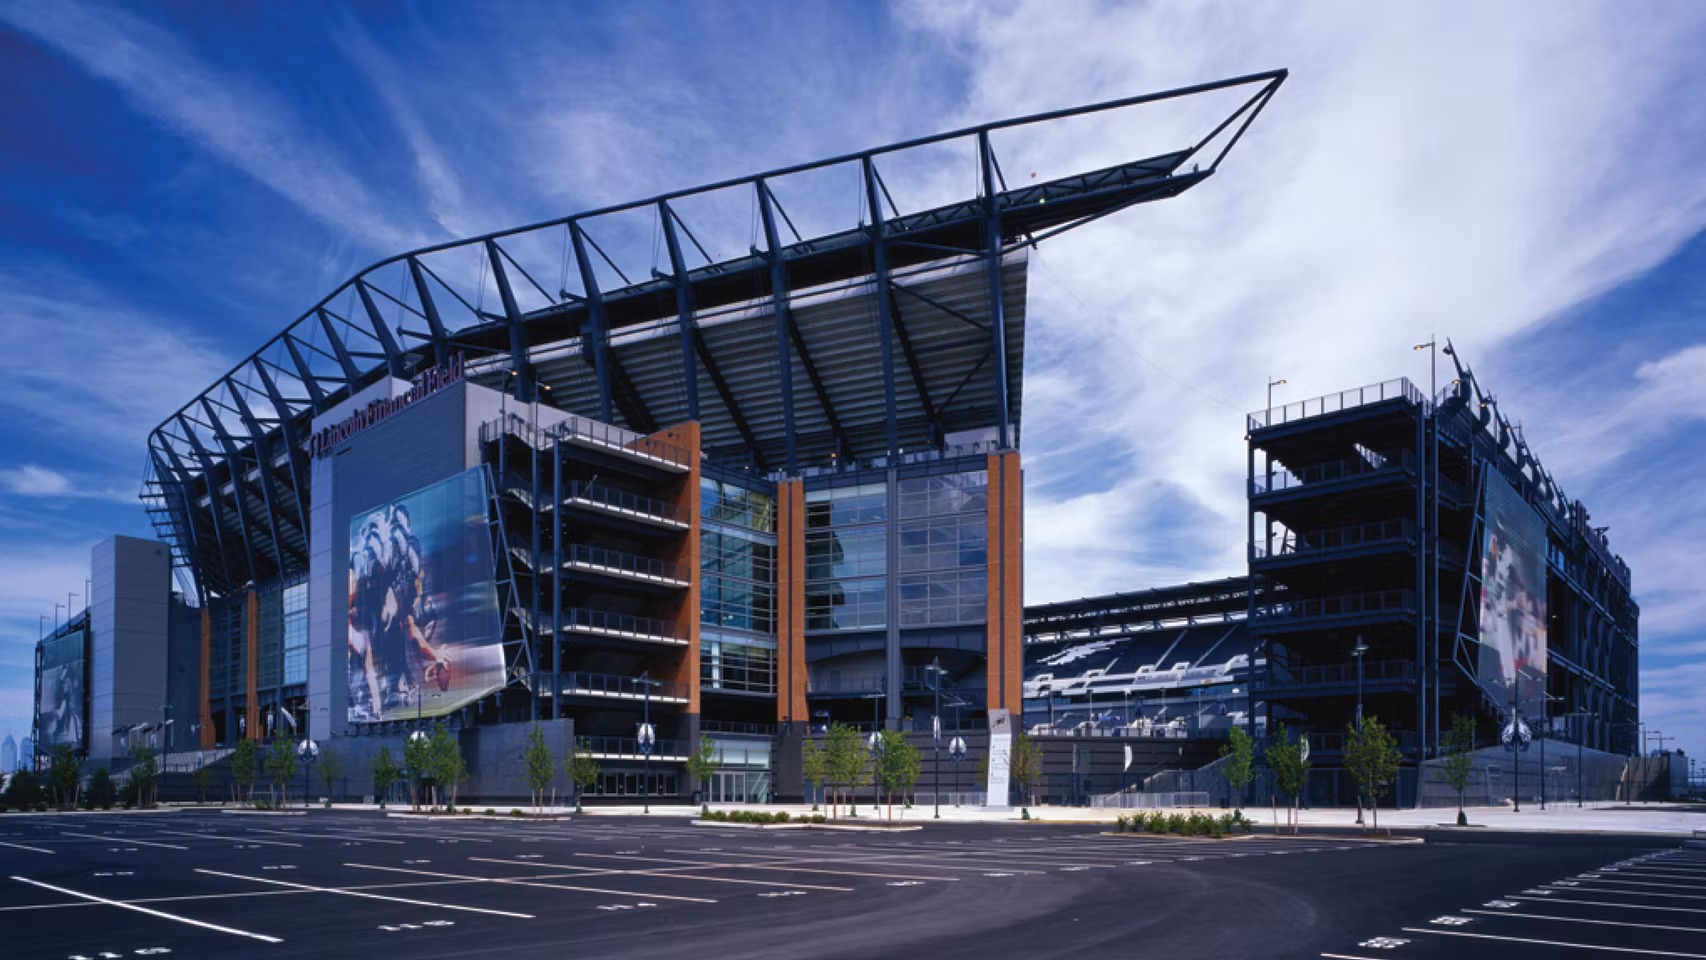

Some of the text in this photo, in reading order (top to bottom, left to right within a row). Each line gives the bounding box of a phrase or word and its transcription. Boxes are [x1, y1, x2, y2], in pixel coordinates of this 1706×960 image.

[321, 350, 464, 452] Lincoln Financial Field
